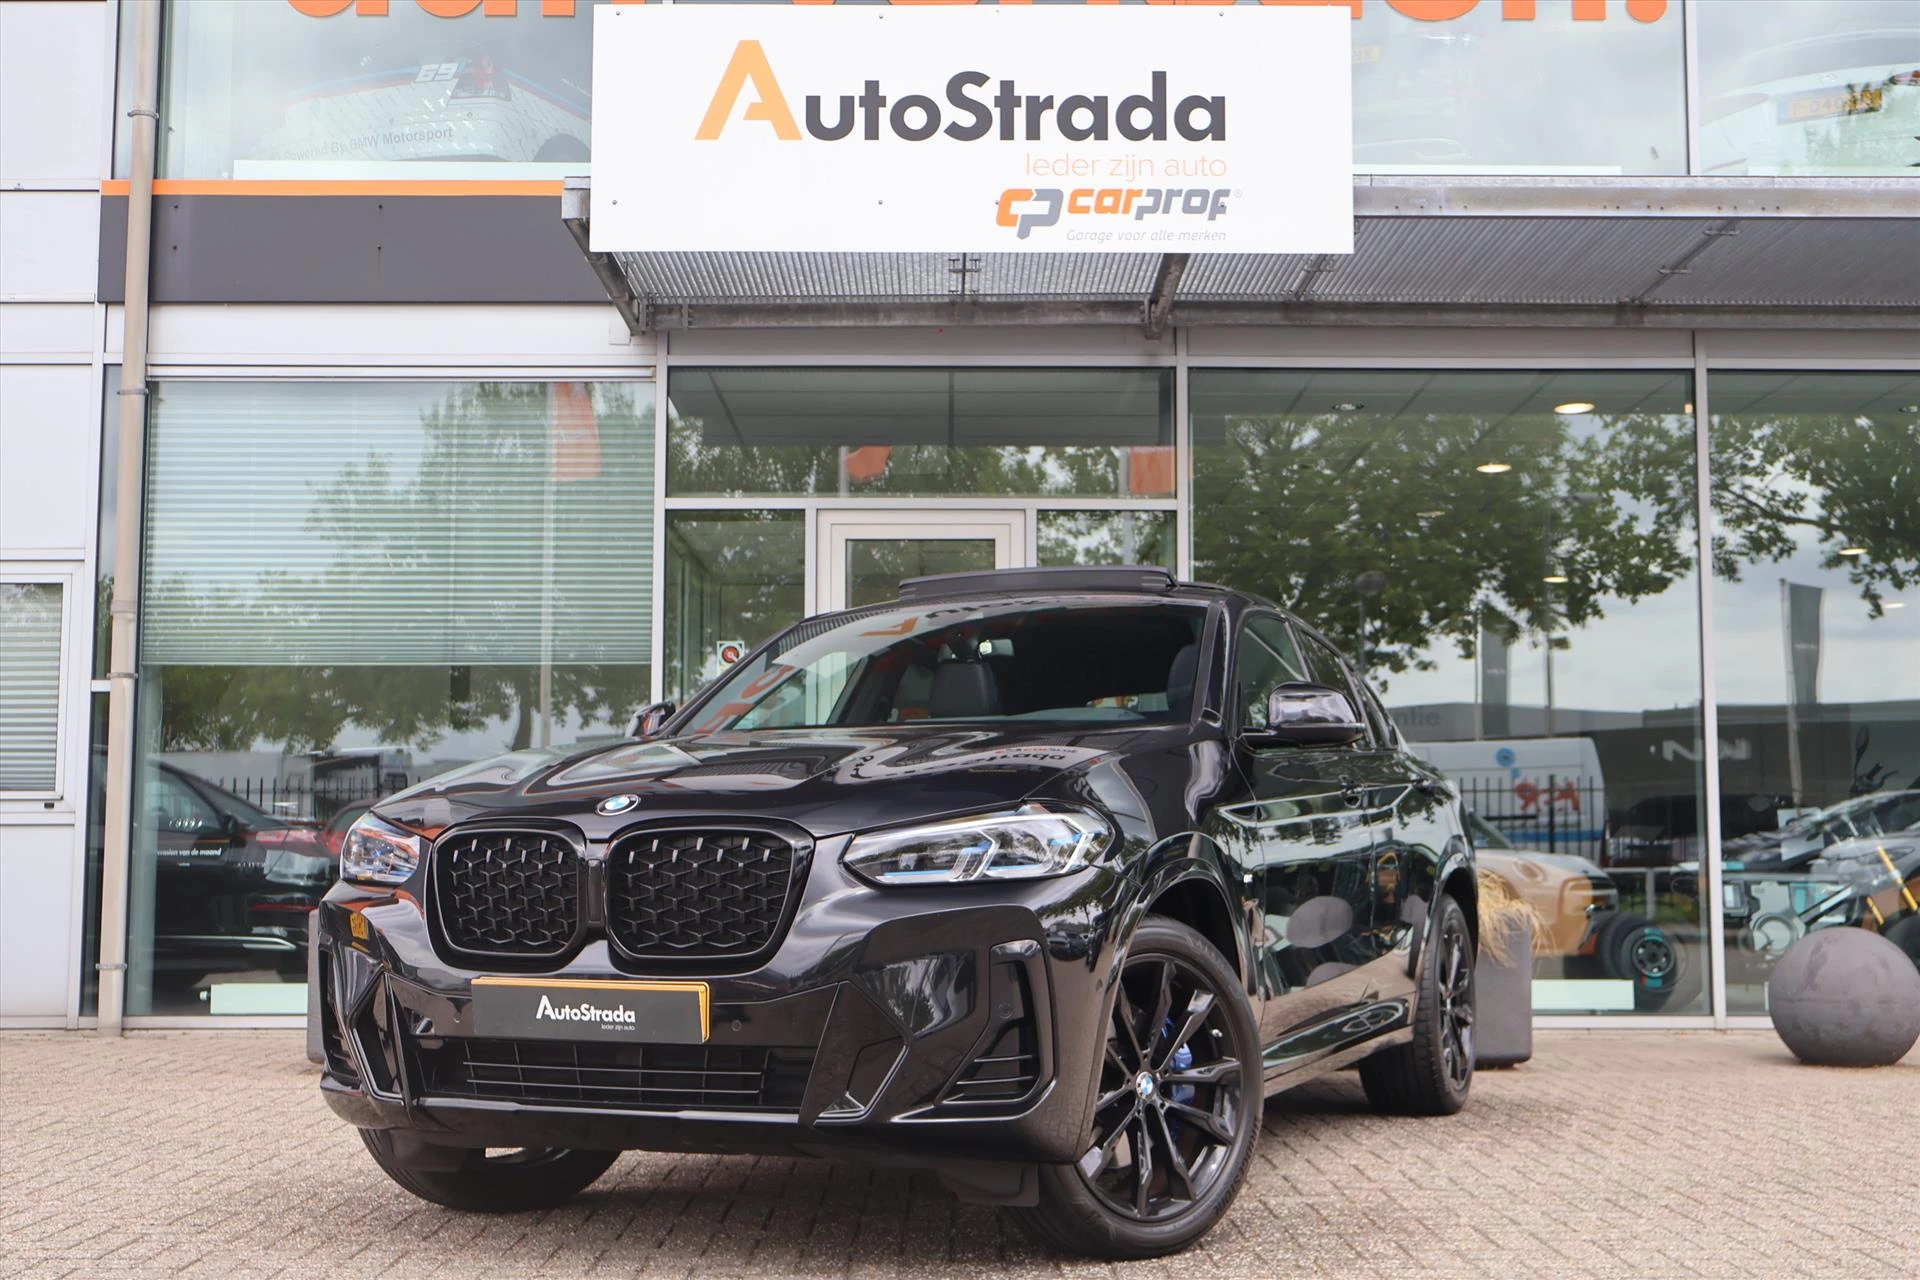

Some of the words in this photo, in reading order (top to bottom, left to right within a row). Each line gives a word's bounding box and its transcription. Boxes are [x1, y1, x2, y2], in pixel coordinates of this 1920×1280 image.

[415, 63, 459, 82] 69
[695, 39, 1227, 142] AutoStrada
[350, 135, 380, 150] BMW
[383, 127, 454, 146] Motorsport
[1108, 154, 1155, 182] zijn
[1164, 155, 1228, 177] auto
[1066, 188, 1231, 222] carprof
[1066, 229, 1113, 244] Garage
[1118, 231, 1146, 241] voor
[1150, 230, 1174, 241] alle
[1178, 230, 1227, 241] merken
[200, 848, 222, 856] maand
[536, 994, 636, 1023] AutoStrada
